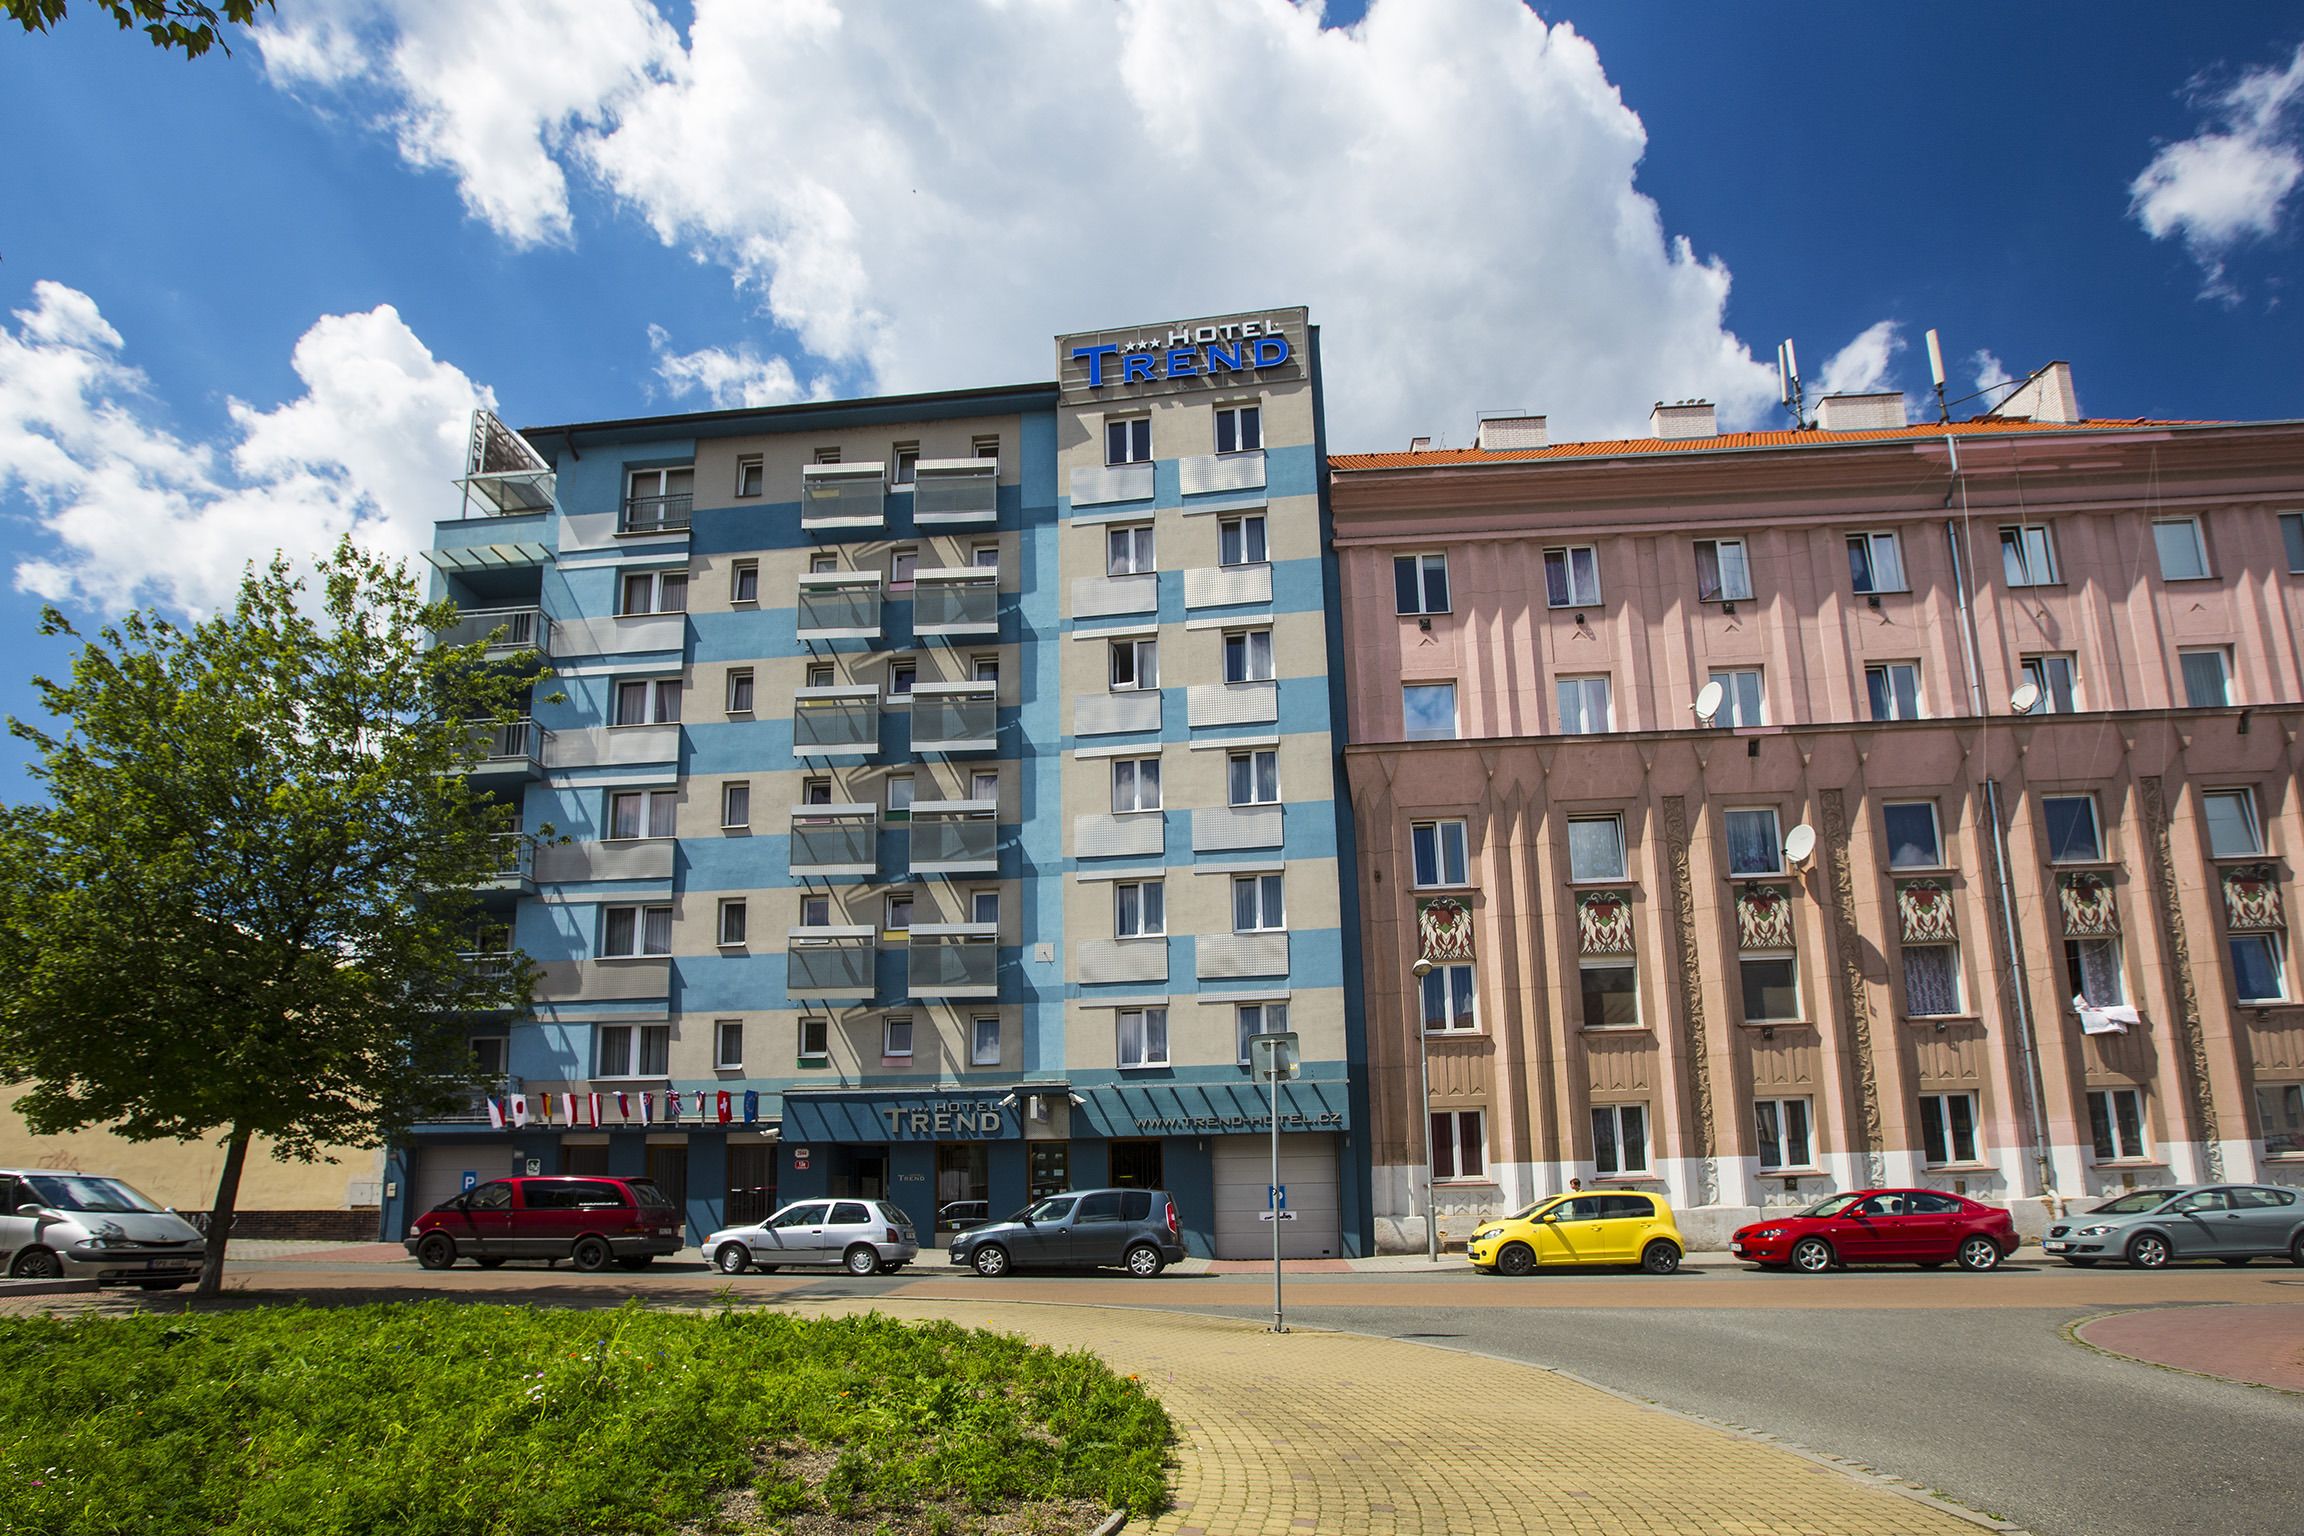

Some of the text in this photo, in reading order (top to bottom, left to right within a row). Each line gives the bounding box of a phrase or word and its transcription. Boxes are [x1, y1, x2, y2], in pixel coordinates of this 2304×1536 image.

[1168, 319, 1284, 347] HOTEL
[1071, 338, 1289, 388] TREND
[934, 1102, 999, 1112] HOTEL
[883, 1108, 1000, 1133] TREND
[464, 1176, 475, 1189] P
